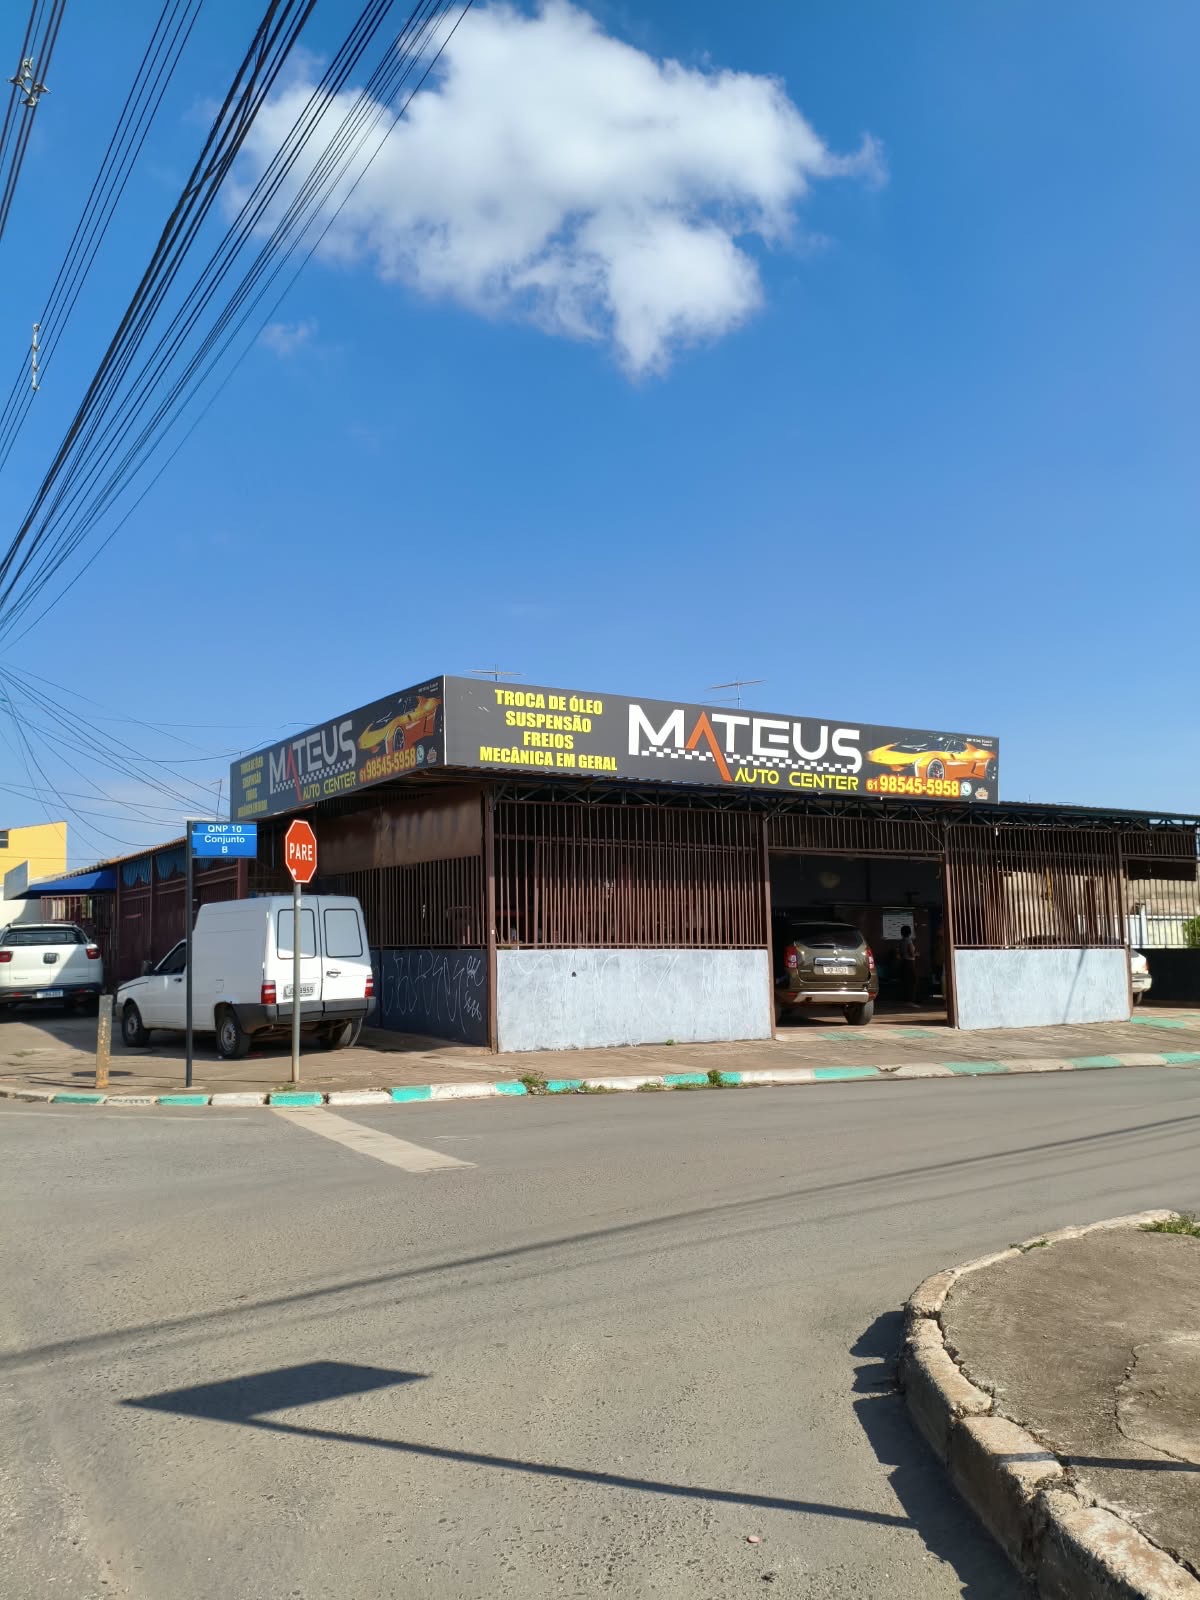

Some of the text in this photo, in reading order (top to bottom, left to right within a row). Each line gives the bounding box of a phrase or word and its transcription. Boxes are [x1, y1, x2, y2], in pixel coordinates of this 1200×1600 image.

[494, 689, 603, 715] TROCA DE ÓLEO
[505, 710, 592, 733] SUSPENSÃO
[523, 731, 574, 749] FREIOS
[628, 704, 863, 782] MATEUS
[269, 719, 357, 802] MATEUS
[366, 748, 417, 778] 98545-5958
[479, 746, 617, 771] MECÂNICA EM GERAL
[303, 770, 356, 800] AUTO CENTER
[734, 767, 859, 791] AUTO CENTER
[867, 780, 878, 790] 61
[880, 775, 959, 796] 98545-5958
[204, 835, 245, 844] Conjunto
[207, 824, 242, 833] QNP 10
[221, 846, 228, 854] B
[289, 842, 313, 861] PARE
